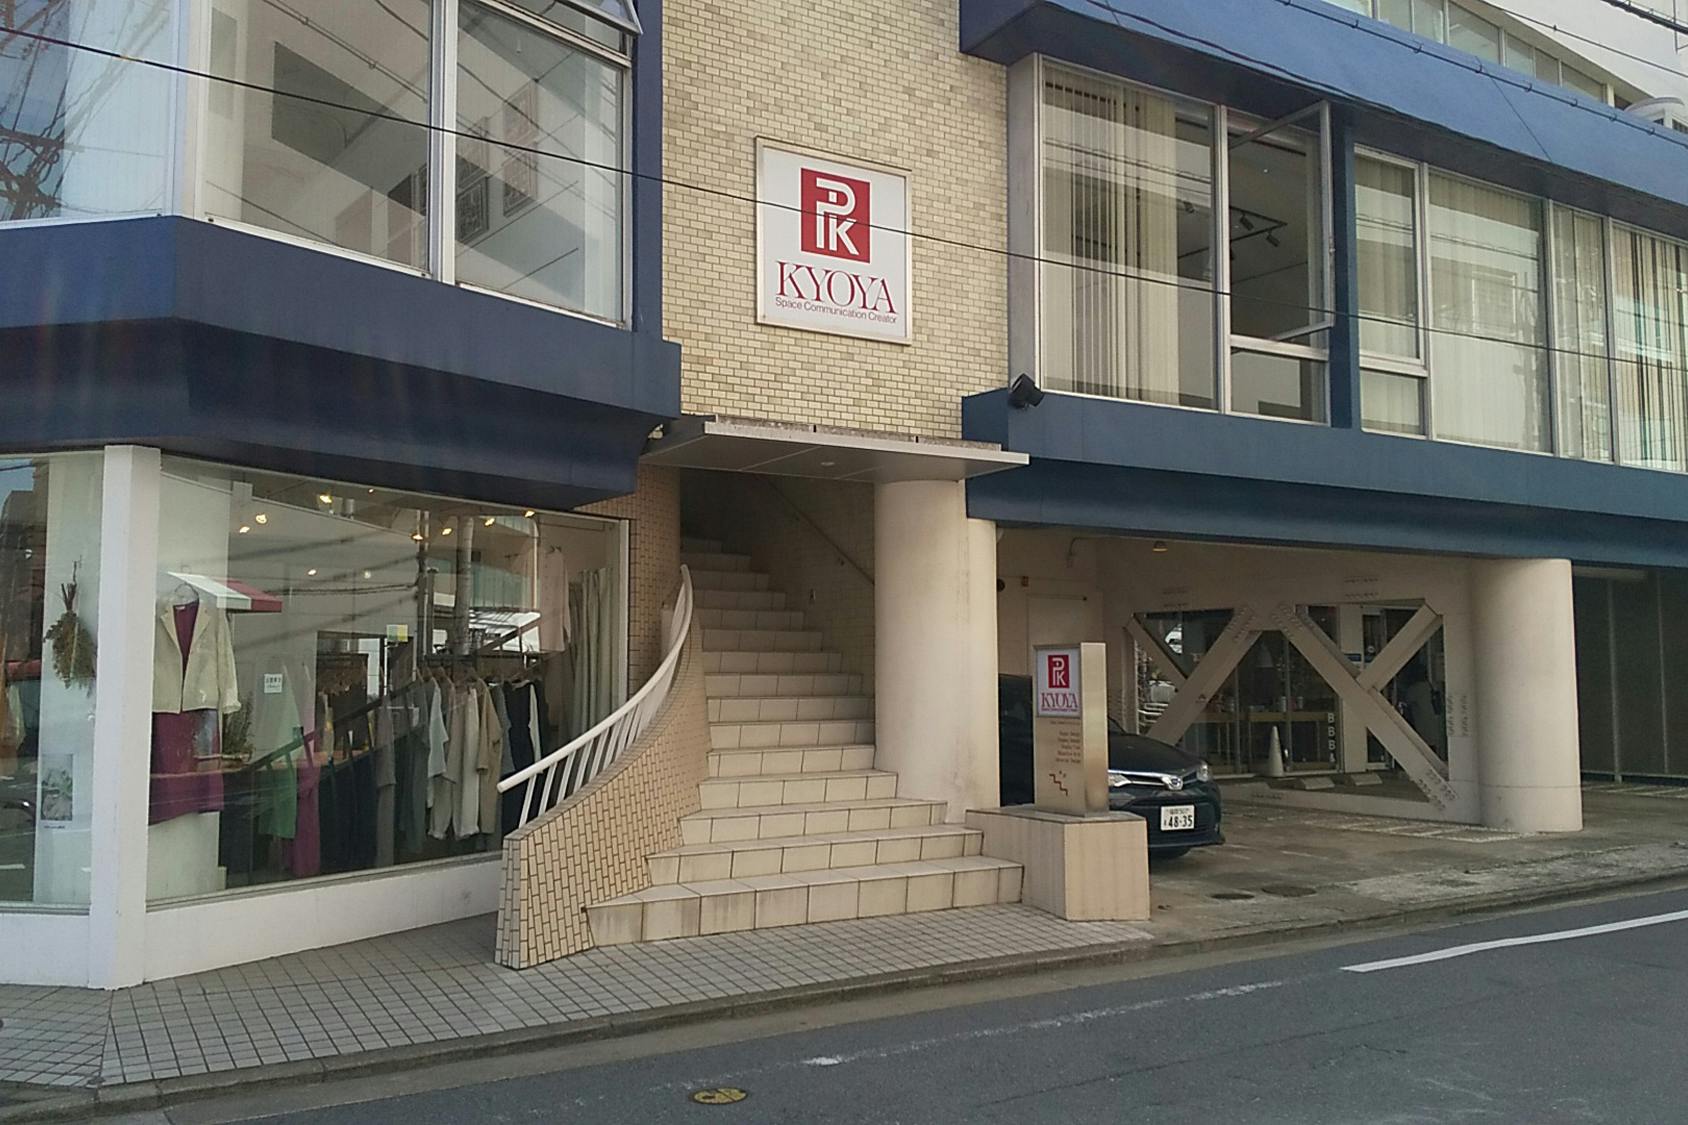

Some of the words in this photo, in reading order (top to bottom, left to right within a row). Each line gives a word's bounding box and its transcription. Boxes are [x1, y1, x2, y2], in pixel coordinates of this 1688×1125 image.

[776, 260, 898, 314] KYOYA
[775, 297, 803, 310] Space
[804, 300, 867, 320] Communication
[868, 312, 898, 324] Creator
[1041, 692, 1078, 708] KYOYA
